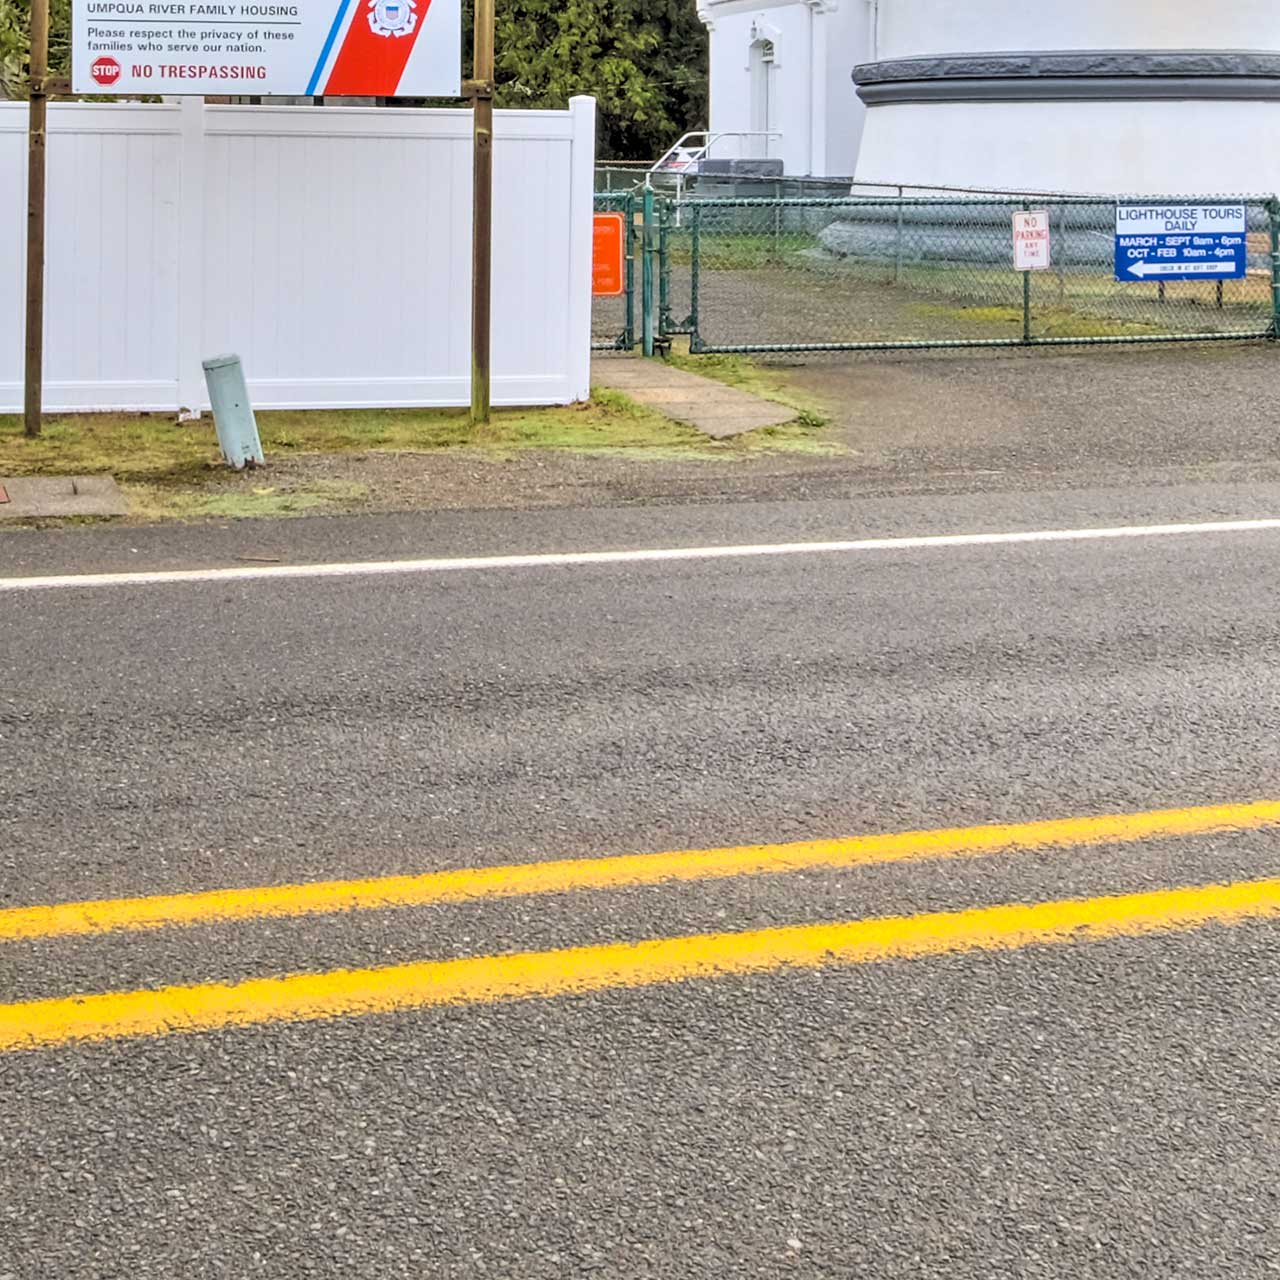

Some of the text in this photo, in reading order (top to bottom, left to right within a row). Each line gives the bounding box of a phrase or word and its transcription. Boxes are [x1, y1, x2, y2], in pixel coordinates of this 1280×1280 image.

[87, 3, 298, 16] UMPQUA RIVER FAMILY HOUSING
[88, 27, 295, 42] Please respect the privacy of these
[88, 40, 267, 53] families who serve our nation.
[92, 64, 120, 76] STOP
[132, 64, 267, 79] NO TRESPASSING
[1118, 208, 1243, 220] LIGHTHOUSE TOURS
[1024, 216, 1037, 228] NO
[1164, 221, 1197, 231] DAILY
[1120, 237, 1157, 246] MARCH
[1165, 236, 1191, 246] SEPT
[1221, 236, 1241, 246] 6pm
[1127, 248, 1149, 258] OCT
[1157, 248, 1176, 257] FEB
[1183, 248, 1206, 257] 10am
[1214, 247, 1234, 258] 4pm
